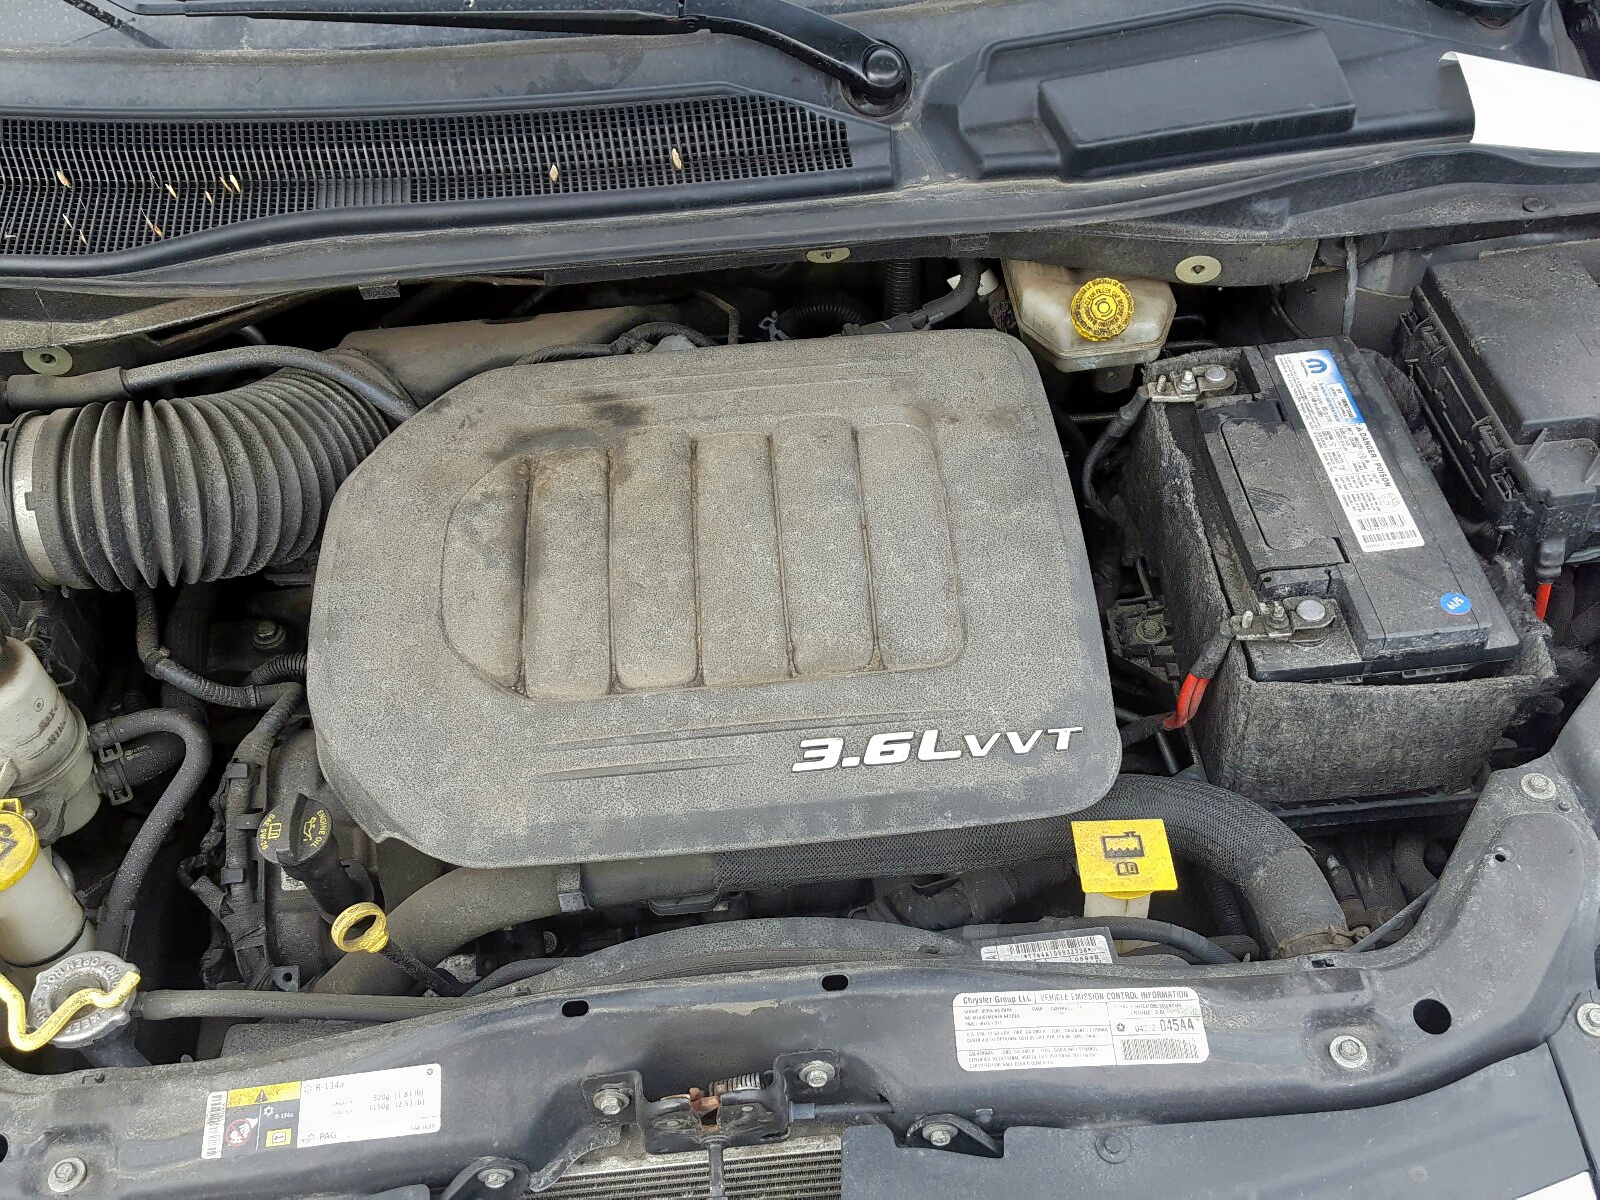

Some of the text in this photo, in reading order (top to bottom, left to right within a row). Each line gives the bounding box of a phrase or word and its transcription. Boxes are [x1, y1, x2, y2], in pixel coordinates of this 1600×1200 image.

[1360, 432, 1391, 487] DANGER POISON
[791, 726, 1084, 772] 3.6L VVT
[310, 809, 327, 849] ENGINE OIL
[66, 957, 100, 971] OPEN
[963, 996, 992, 1006] Chrysler
[994, 995, 1016, 1005] Group
[1040, 992, 1069, 1002] VEHICLE
[1071, 991, 1104, 1001] EMISSION
[1106, 991, 1139, 1000] CONTROL
[1140, 990, 1189, 1000] INFORMATION
[274, 1112, 294, 1120] R-134a
[319, 1131, 337, 1141] PAG
